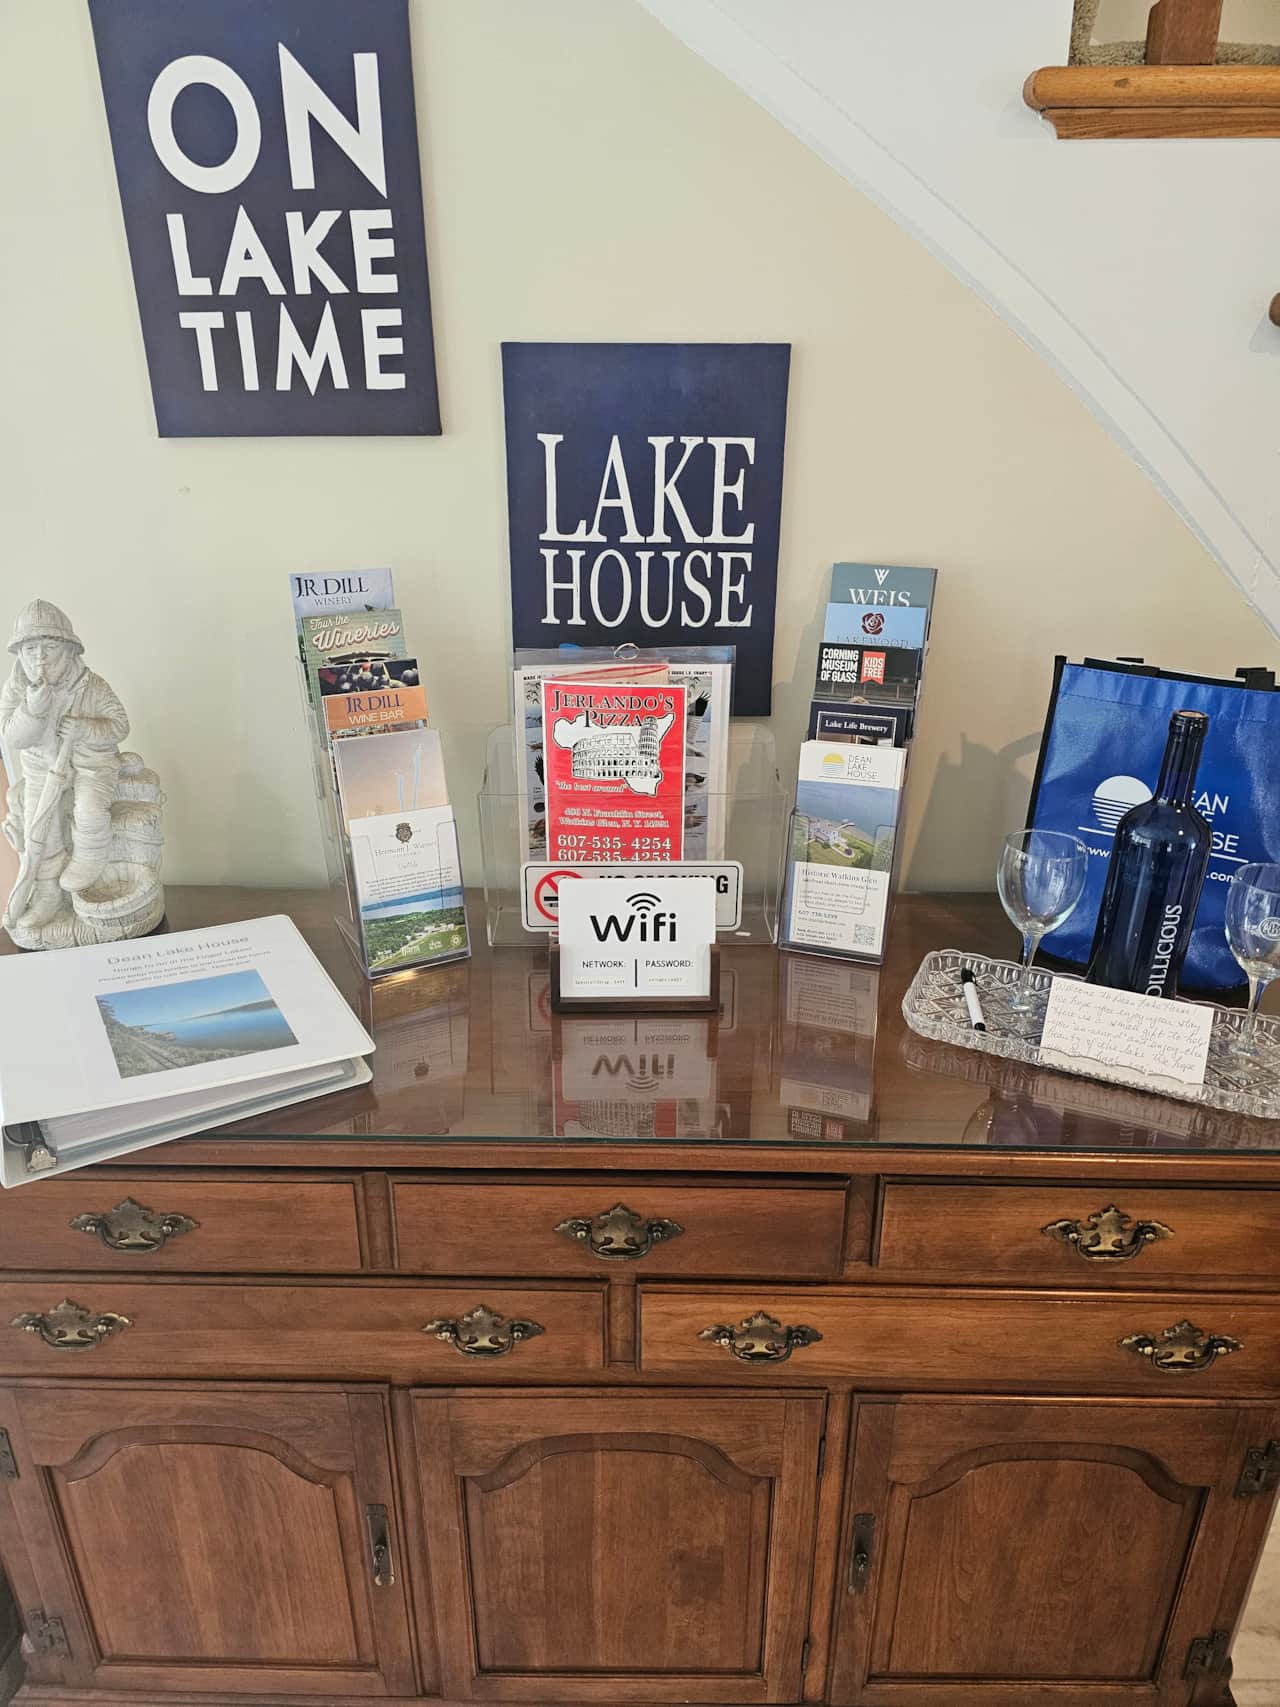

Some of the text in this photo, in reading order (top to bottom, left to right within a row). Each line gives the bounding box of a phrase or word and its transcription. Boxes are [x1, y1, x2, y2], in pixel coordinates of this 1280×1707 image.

[147, 42, 387, 199] ON
[166, 204, 398, 296] LAKE
[178, 300, 406, 396] TIME
[537, 433, 756, 544] LAKE
[539, 548, 752, 627] HOUSE
[314, 596, 353, 606] WINERY
[848, 588, 912, 607] WEIS
[310, 615, 350, 631] Tour the
[312, 620, 400, 651] Wineries
[823, 648, 859, 660] CORNING
[821, 659, 858, 671] MUSEUM
[864, 657, 884, 669] KIDS
[820, 670, 857, 683] OF GLASS
[864, 668, 883, 679] FREE
[349, 710, 404, 725] WINE BAR
[583, 709, 644, 727] PIZZA
[825, 719, 888, 733] Lake Life Brewery
[848, 754, 872, 764] DEAN
[847, 770, 878, 779] HOUSE
[848, 763, 868, 771] LAKE
[590, 912, 677, 942] Wifi
[107, 936, 249, 964] Dean Lake House
